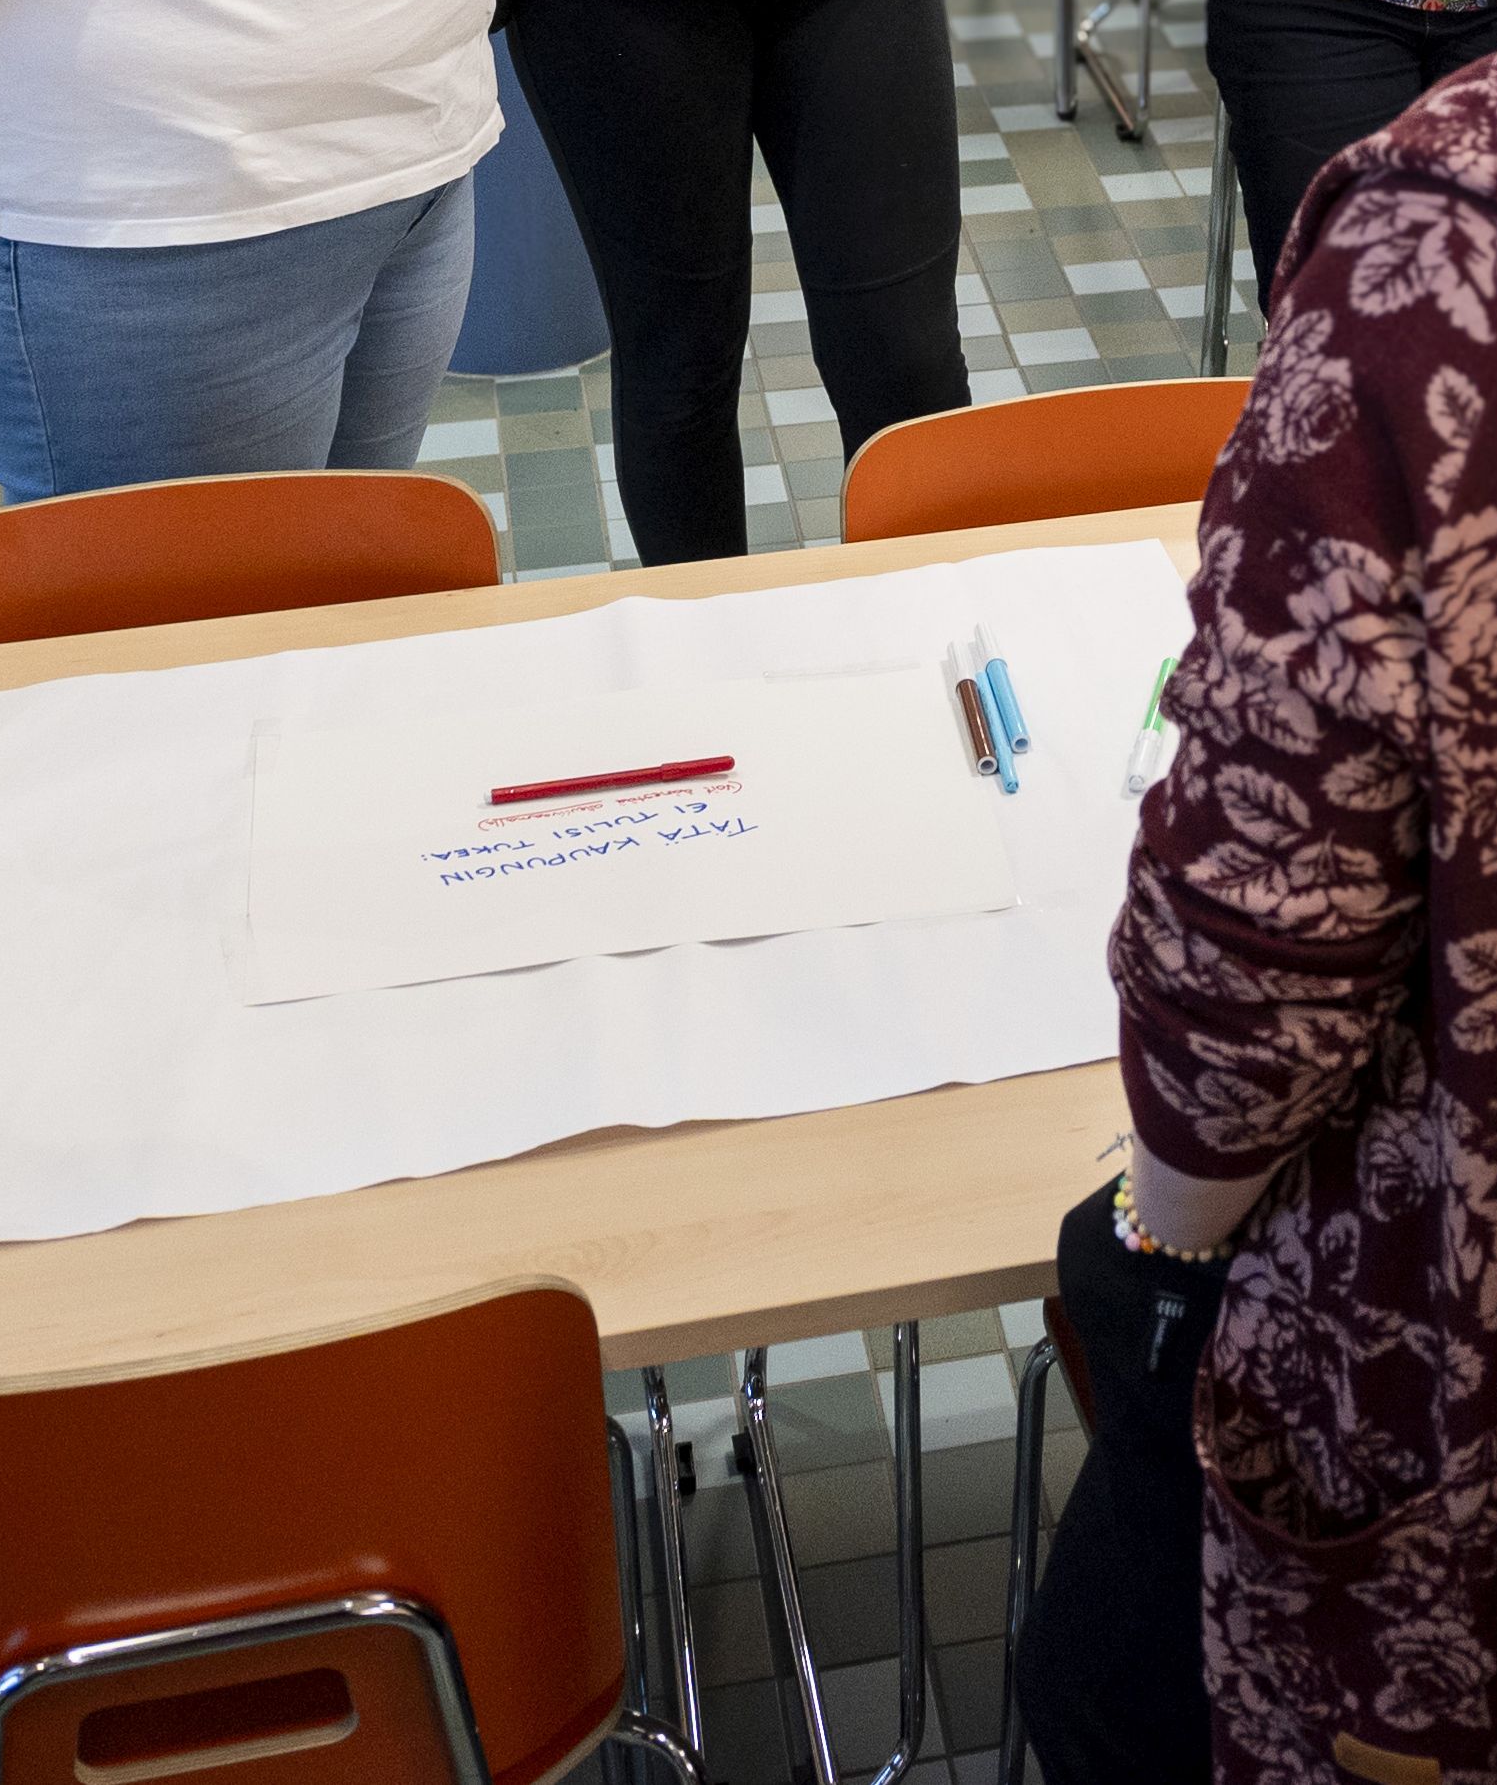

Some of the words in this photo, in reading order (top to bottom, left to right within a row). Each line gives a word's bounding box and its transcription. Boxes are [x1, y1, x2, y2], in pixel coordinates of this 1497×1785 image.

[551, 808, 656, 841] TULISI
[673, 800, 709, 817] EI
[656, 815, 759, 848] TÄTÄ
[419, 839, 537, 863] TUKEA:
[438, 836, 642, 887] KAUPUNGIN
